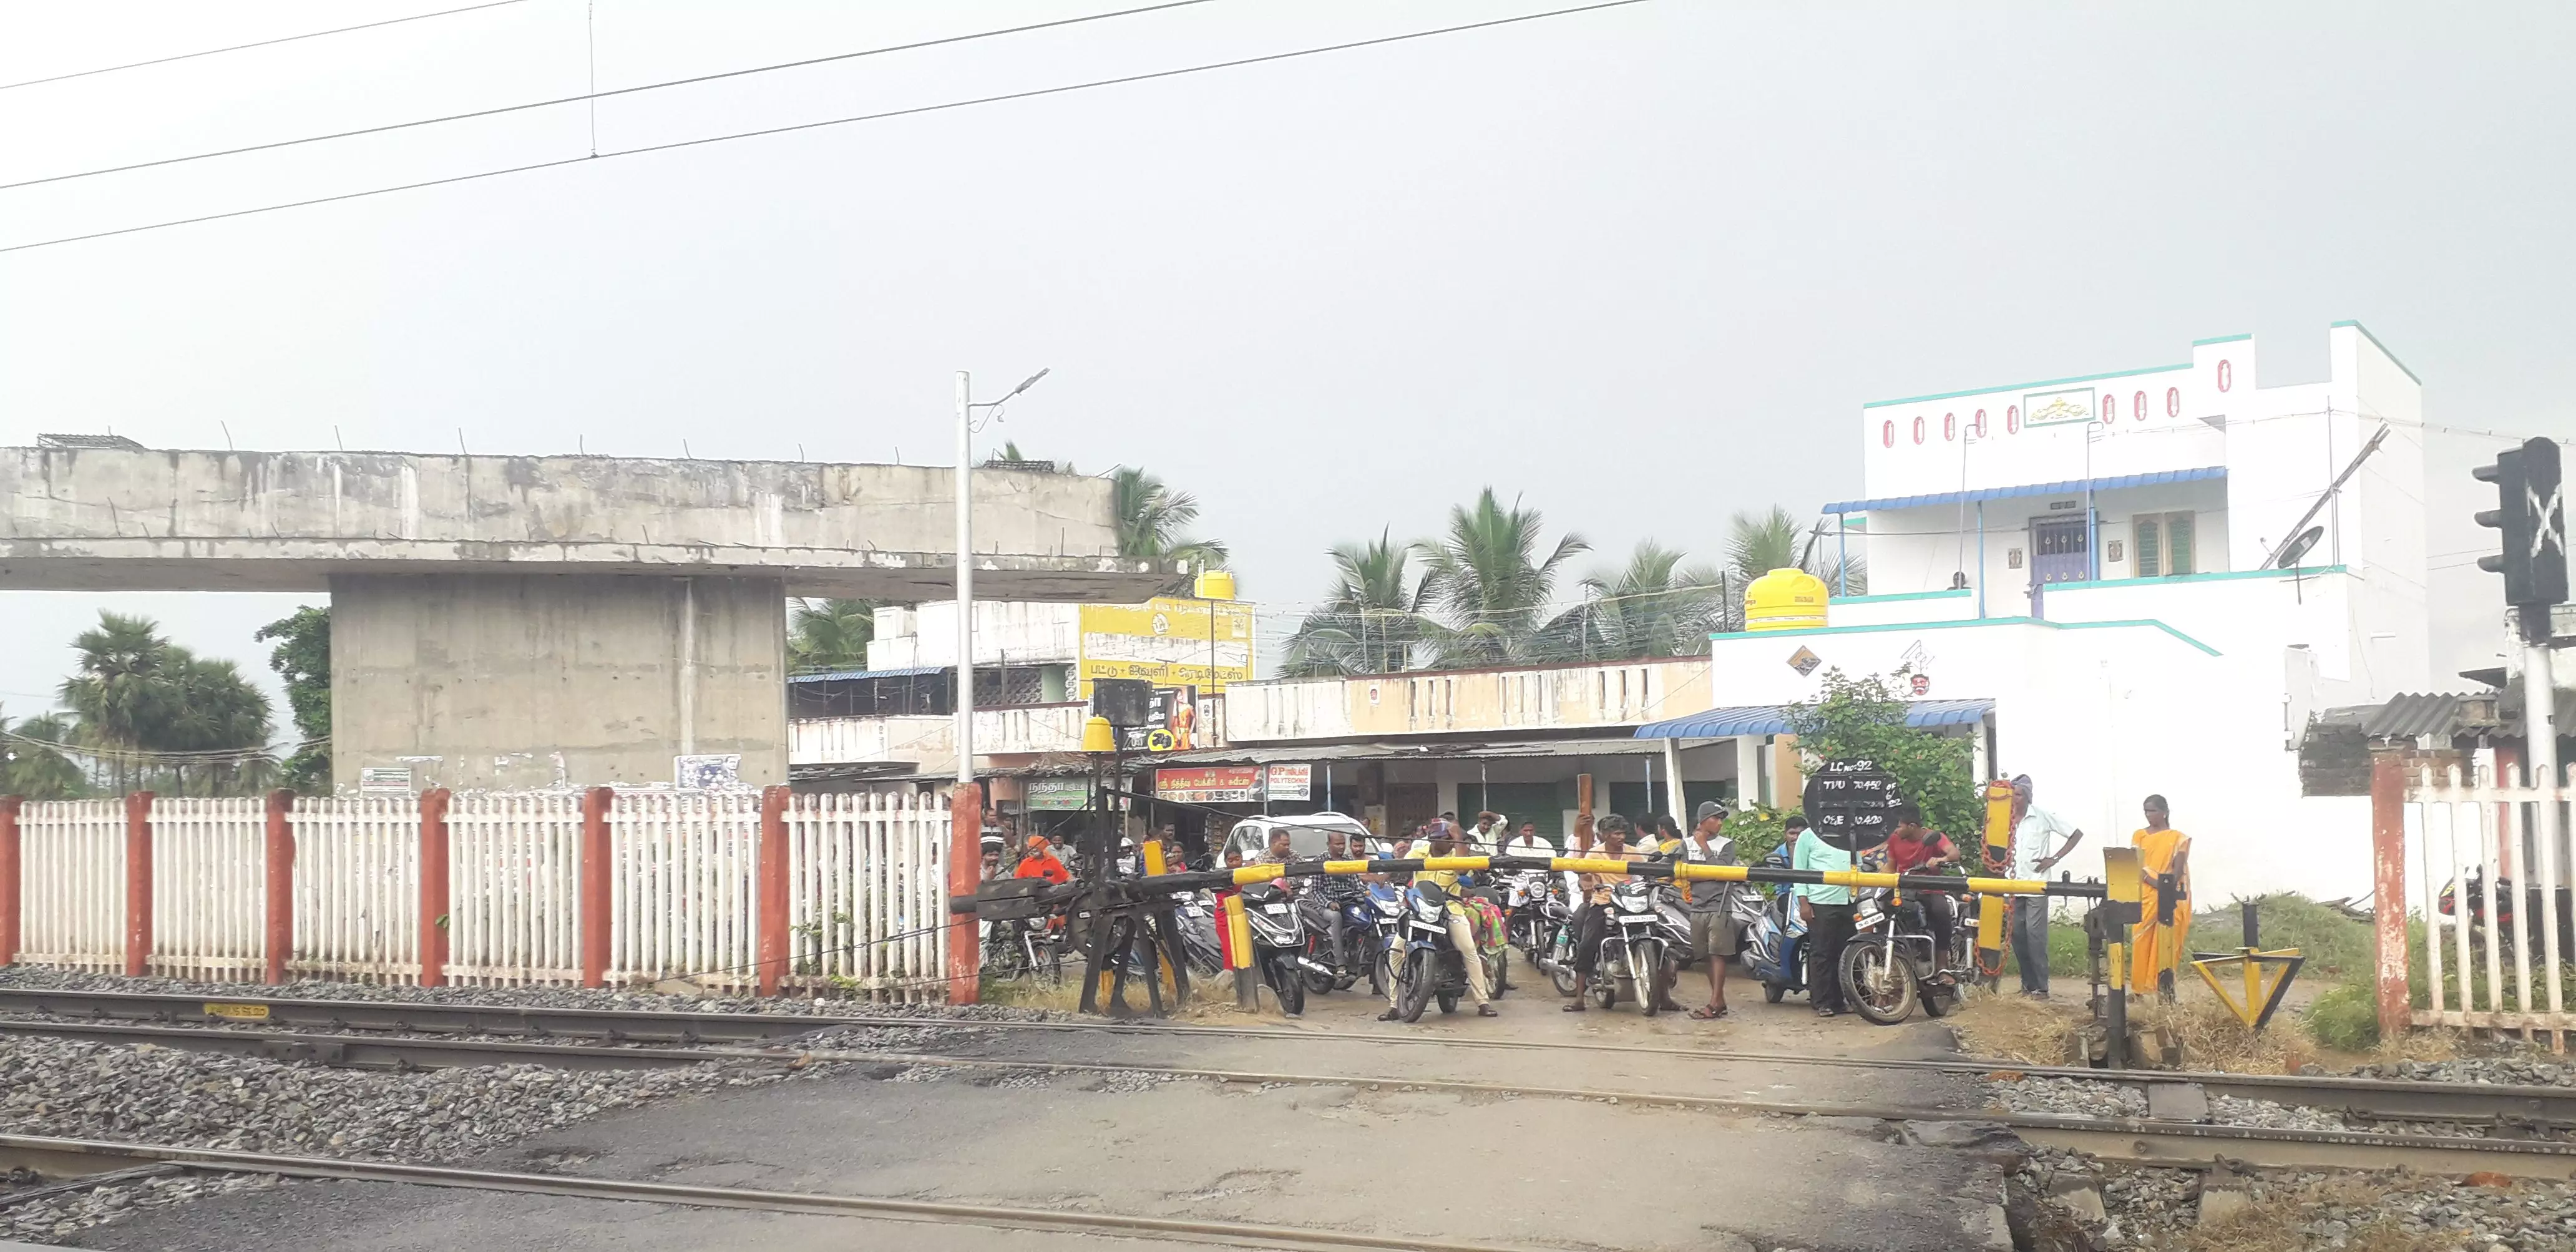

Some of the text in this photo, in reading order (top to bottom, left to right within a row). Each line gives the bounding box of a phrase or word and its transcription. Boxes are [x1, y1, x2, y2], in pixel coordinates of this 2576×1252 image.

[1090, 665, 1118, 677] பட்டு
[1830, 761, 1844, 771] LC
[1029, 780, 1064, 794] நந்தா
[1823, 780, 1845, 790] TVU
